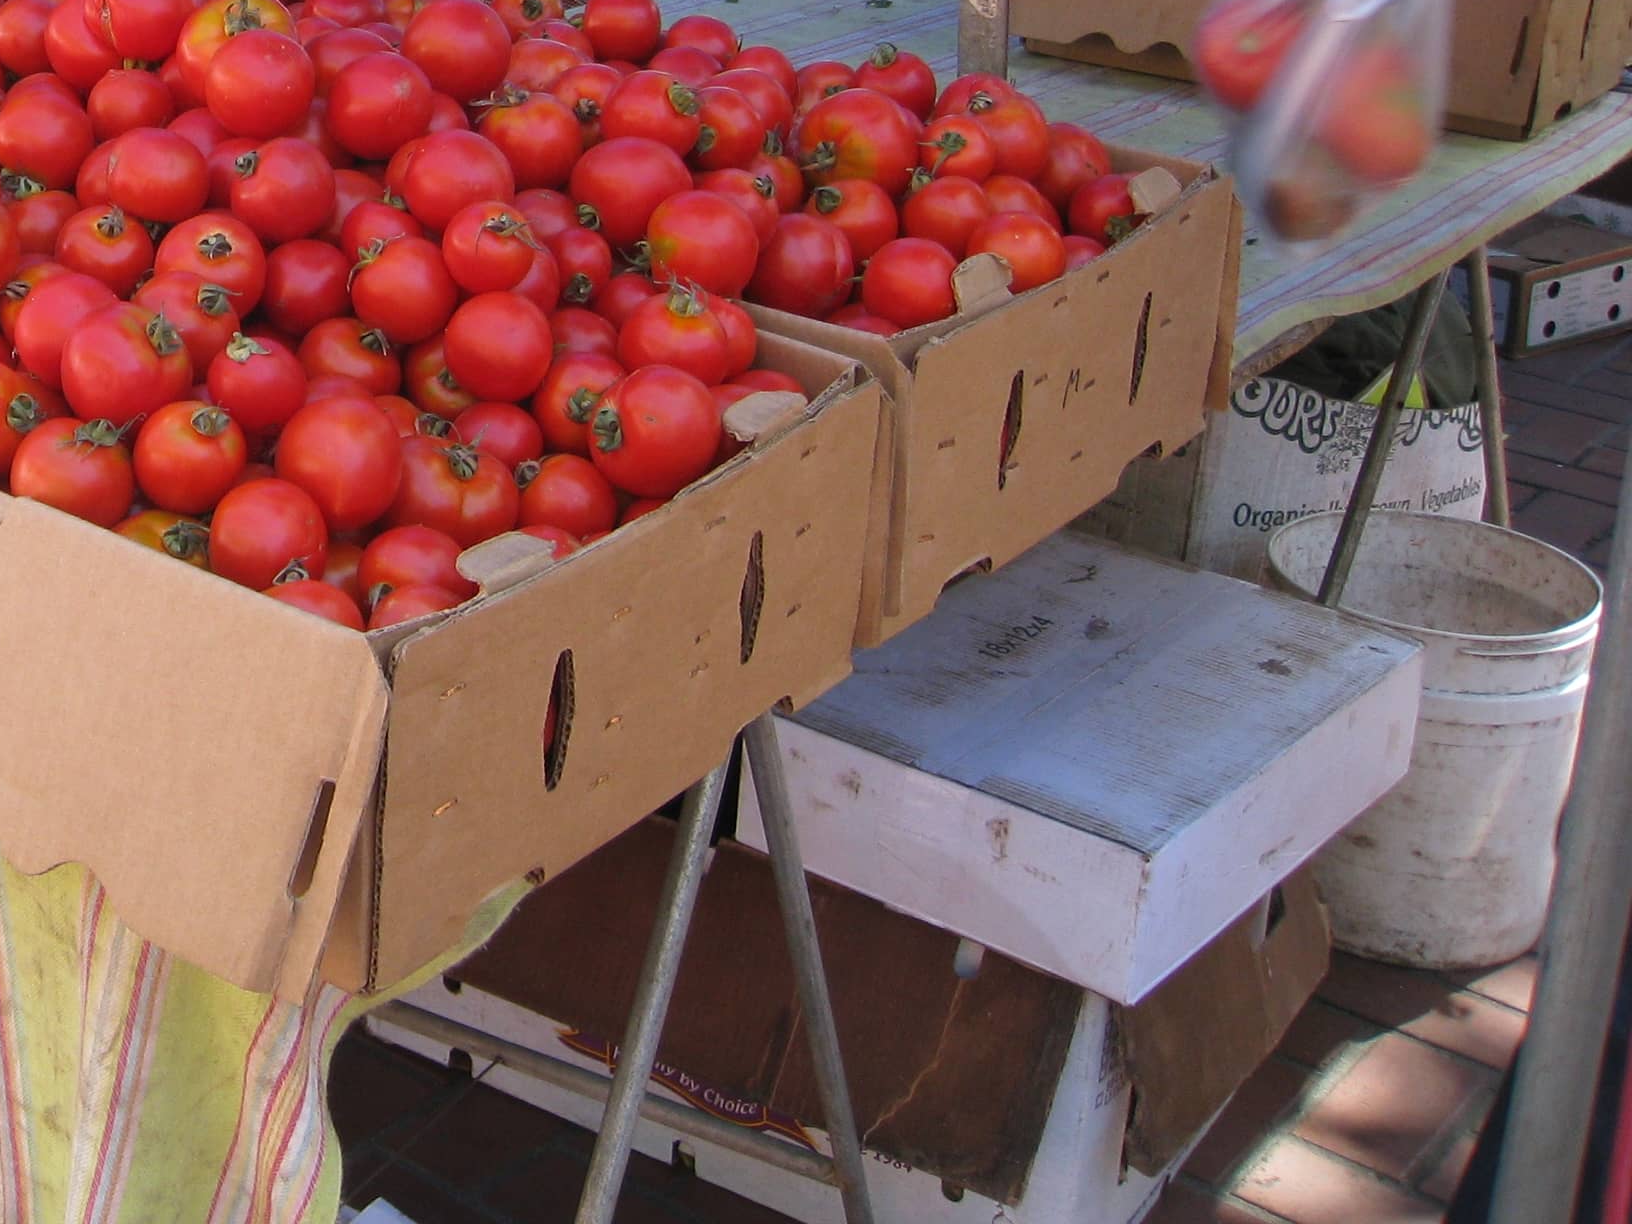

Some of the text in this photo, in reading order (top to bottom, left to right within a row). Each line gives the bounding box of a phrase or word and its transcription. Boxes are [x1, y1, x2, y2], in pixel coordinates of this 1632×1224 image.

[1420, 475, 1482, 512] Vegetables
[977, 614, 1055, 659] 18x12x4
[679, 1072, 758, 1116] by Choice
